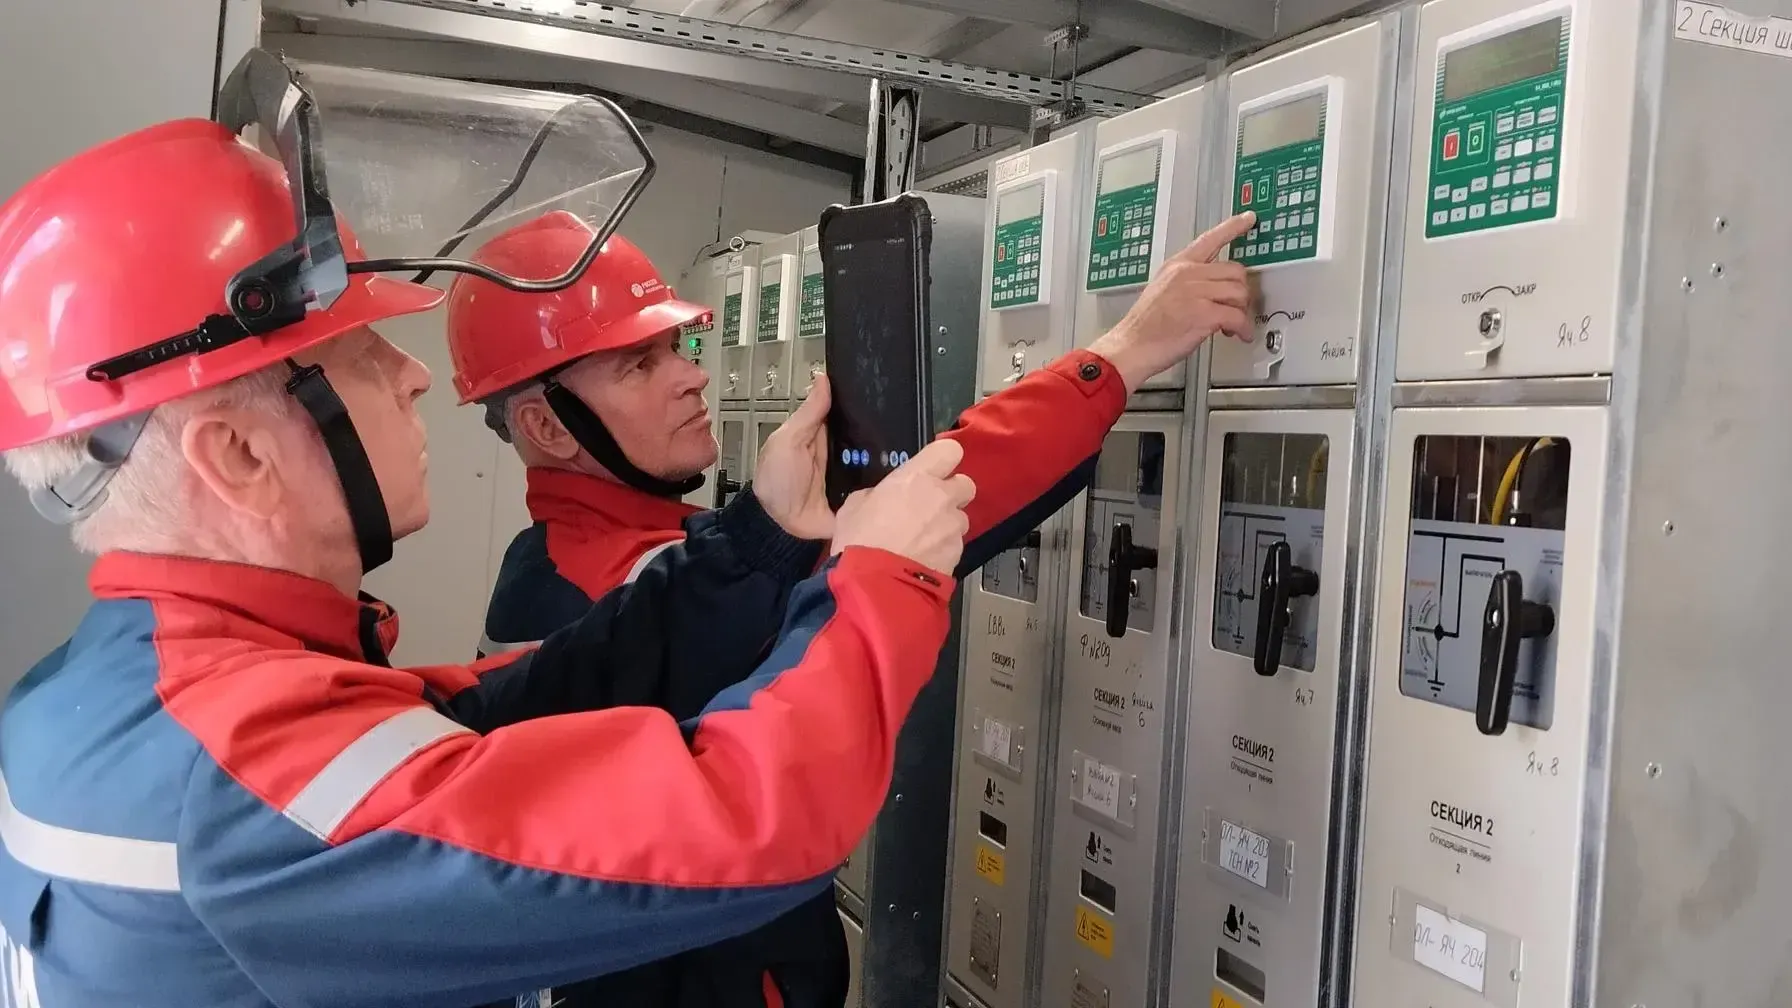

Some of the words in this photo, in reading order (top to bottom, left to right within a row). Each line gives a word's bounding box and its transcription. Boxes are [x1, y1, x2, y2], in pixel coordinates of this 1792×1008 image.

[1677, 6, 1693, 32] 2
[1699, 9, 1769, 45] Секция
[1775, 29, 1792, 51] ш
[1461, 292, 1481, 304] ОТКР
[1579, 315, 1592, 342] 8
[1093, 687, 1120, 709] СЕКЦИЯ
[1120, 696, 1125, 709] 2
[1138, 711, 1146, 728] 6
[1232, 734, 1268, 761] СЕКЦИЯ
[1268, 747, 1275, 762] 2
[1550, 756, 1560, 777] 8
[1430, 800, 1483, 833] СЕКЦИЯ
[1485, 819, 1494, 837] 2
[1455, 863, 1461, 874] 2
[1460, 944, 1485, 971] 204
